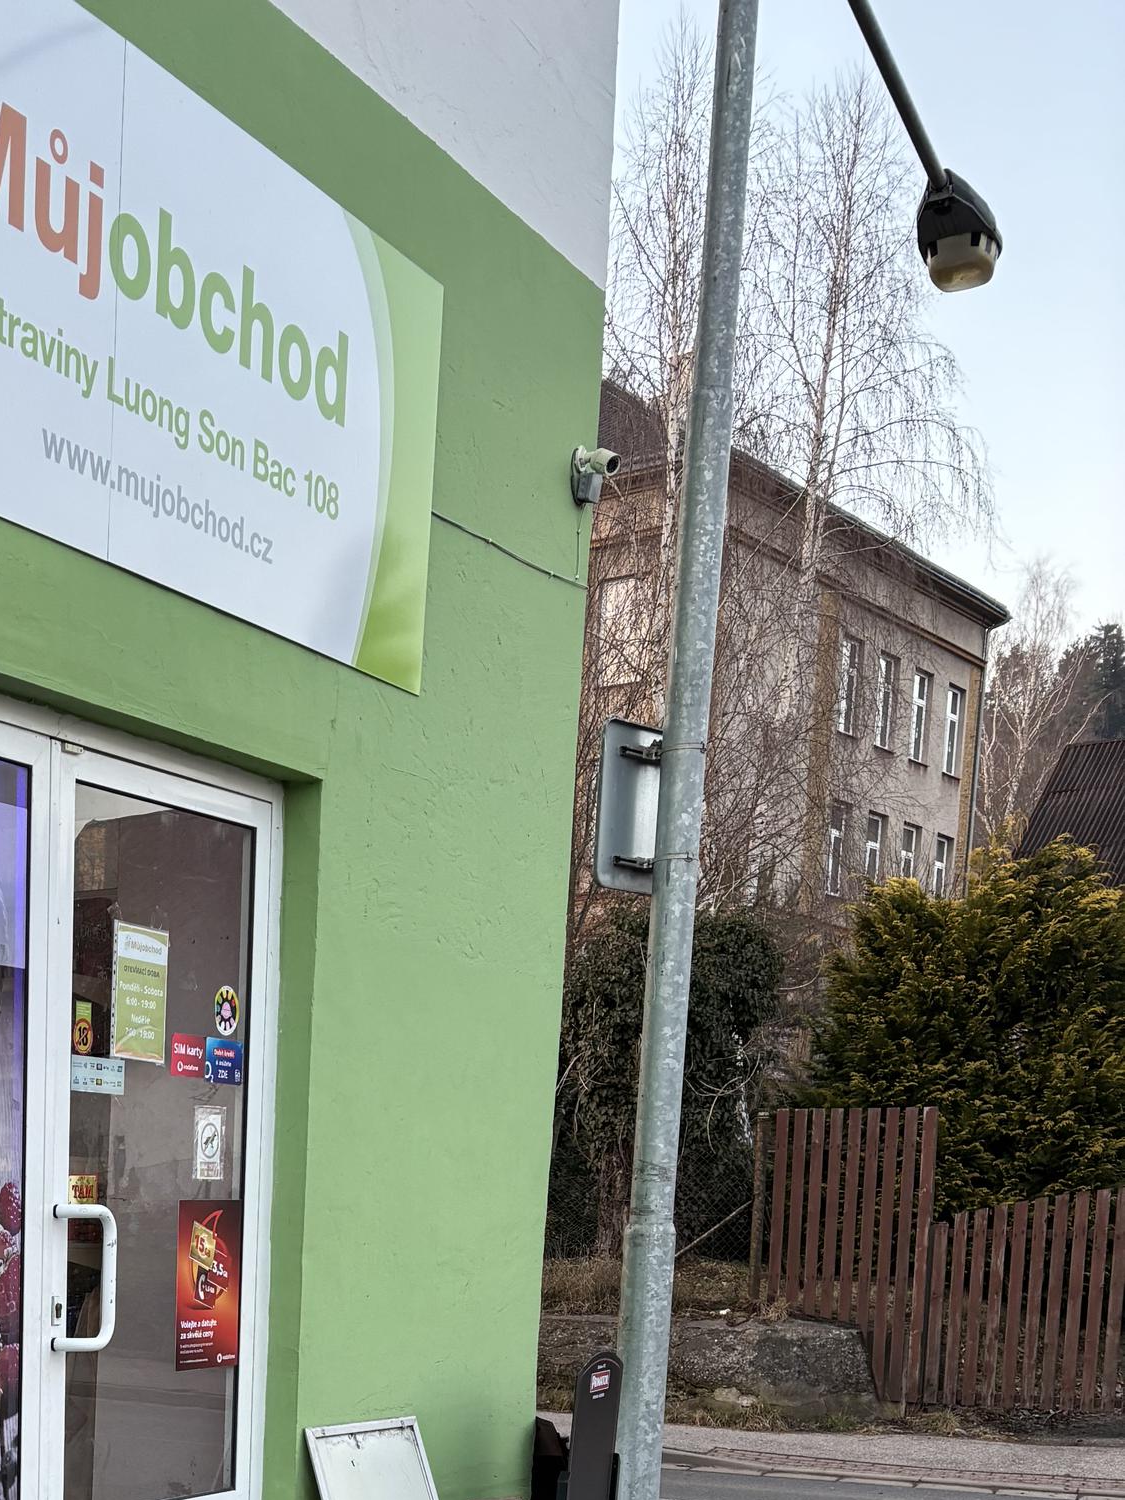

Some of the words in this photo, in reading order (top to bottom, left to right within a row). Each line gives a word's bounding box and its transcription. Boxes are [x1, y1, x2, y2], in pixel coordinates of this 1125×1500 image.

[42, 427, 274, 565] www.mujobchod.cz
[107, 355, 190, 450] Luong
[198, 408, 245, 472] Son
[252, 437, 296, 498] Bac
[304, 469, 339, 521] 108
[174, 1042, 186, 1053] SIM
[186, 1045, 203, 1059] karty
